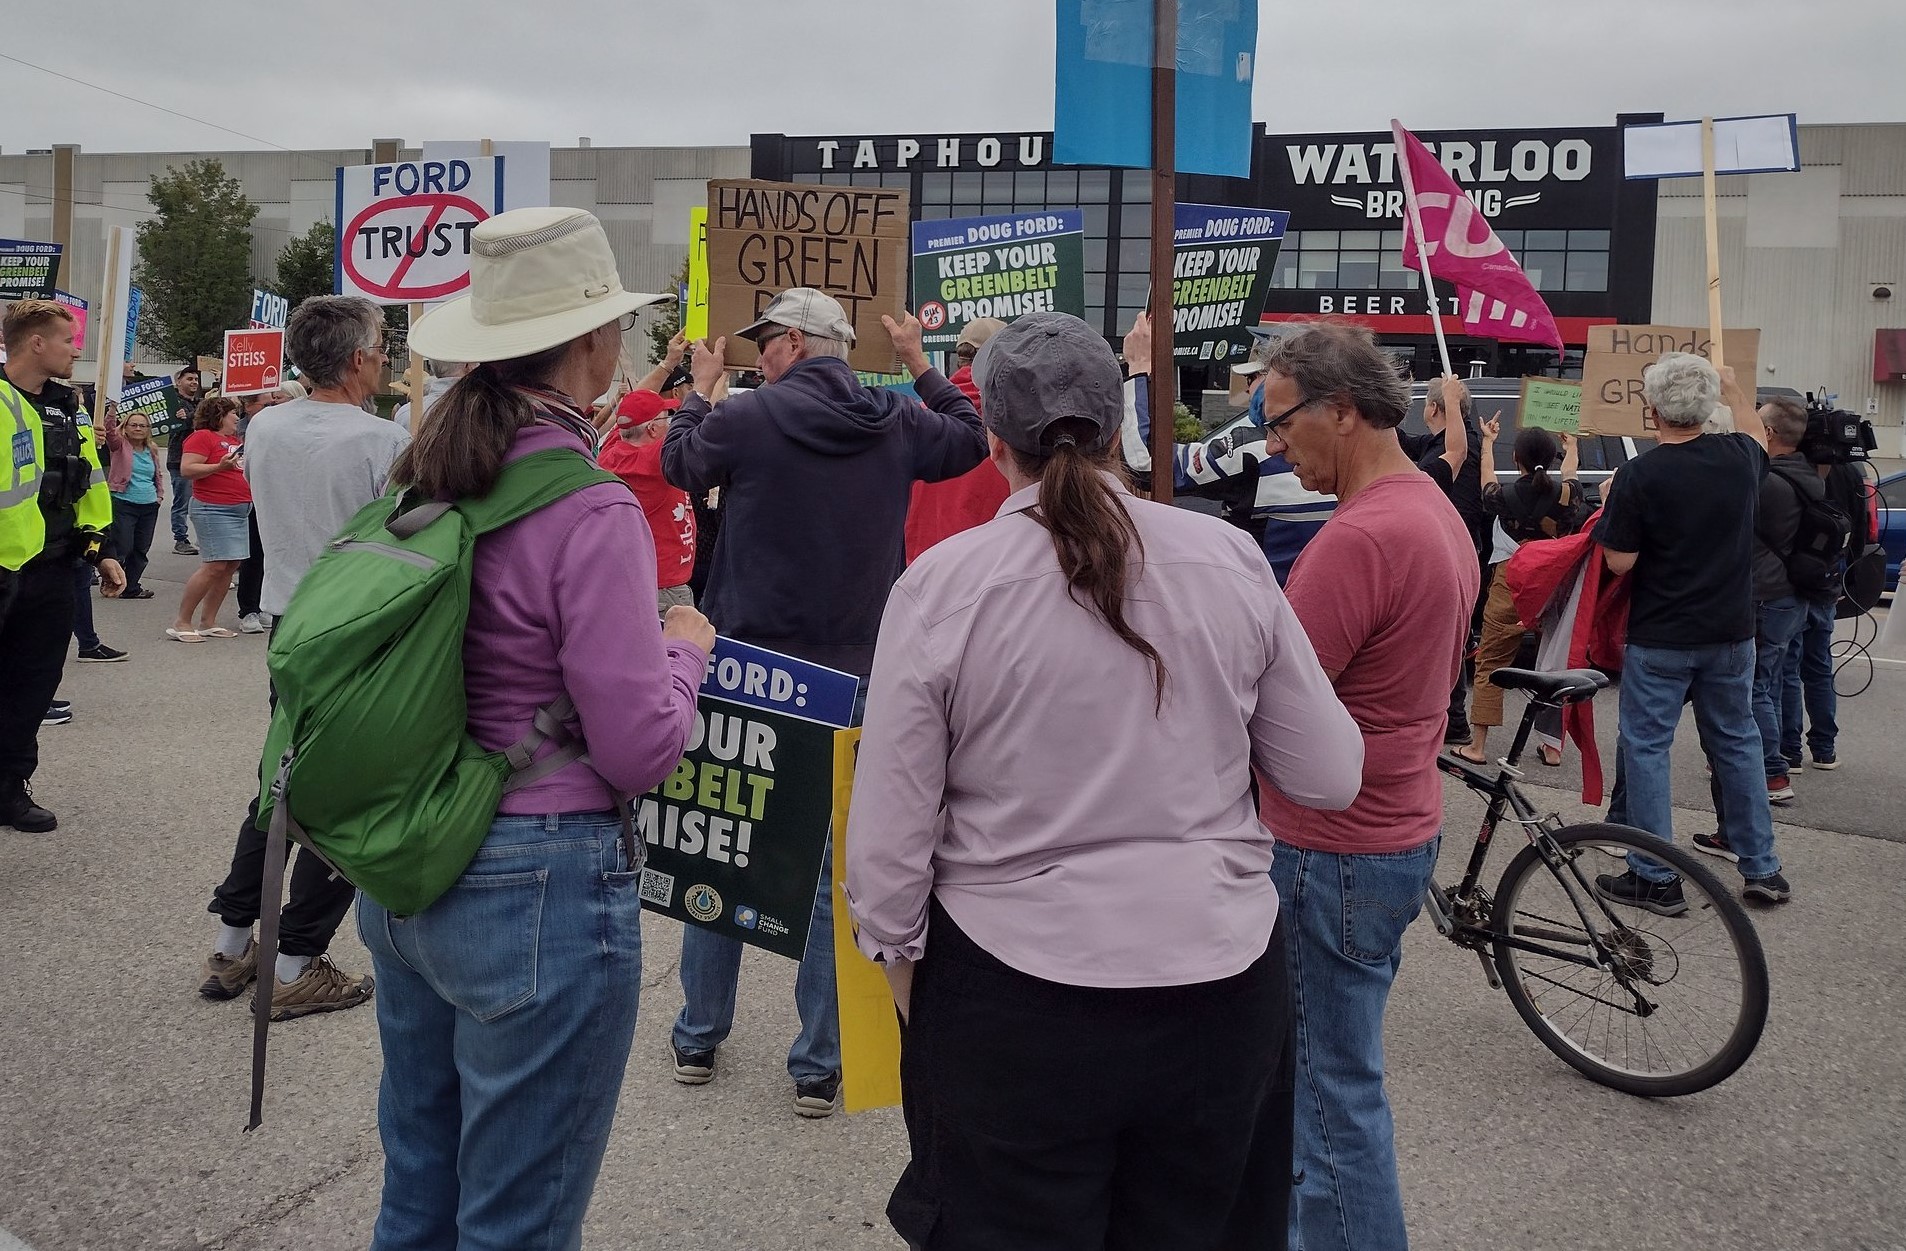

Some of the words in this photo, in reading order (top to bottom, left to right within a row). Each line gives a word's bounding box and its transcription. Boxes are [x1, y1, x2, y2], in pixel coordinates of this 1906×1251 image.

[817, 136, 1043, 169] TAPHOU
[1286, 139, 1592, 185] WATRLOO
[374, 160, 471, 196] FORD
[718, 187, 819, 233] HANDS
[824, 192, 899, 236] OFF
[1366, 189, 1503, 218] BRNG
[358, 221, 479, 260] TRUST
[928, 235, 965, 249] PREMIER
[967, 222, 1012, 243] DOUG
[1016, 216, 1064, 236] FORD:
[1174, 228, 1203, 240] PREMIER
[1205, 217, 1239, 238] DOUG
[1239, 216, 1275, 236] FORD:
[0, 256, 23, 266] KEEP
[25, 256, 50, 267] YOUR
[0, 266, 49, 277] GREENBELT
[738, 233, 879, 297] GREEN
[938, 251, 991, 279] KEEP
[994, 242, 1057, 271] YOUR
[1174, 250, 1215, 278] KEEP
[1217, 246, 1261, 274] YOUR
[0, 277, 45, 287] PROMISE!
[940, 266, 1058, 301] GREENBELT
[251, 288, 288, 328] FORD
[947, 289, 1054, 324] PROMISE!
[1320, 295, 1405, 315] BEER
[230, 336, 254, 352] Kelly
[1611, 328, 1716, 358] Hands
[228, 351, 266, 368] STEISS
[141, 380, 164, 391] FORD:
[116, 400, 135, 413] EEP
[135, 391, 165, 407] YOUR
[702, 653, 808, 707] FORD:
[637, 799, 752, 868] MISE!
[757, 925, 778, 936] FUND
[758, 920, 790, 935] CHANGE
[759, 913, 784, 926] SMALL
